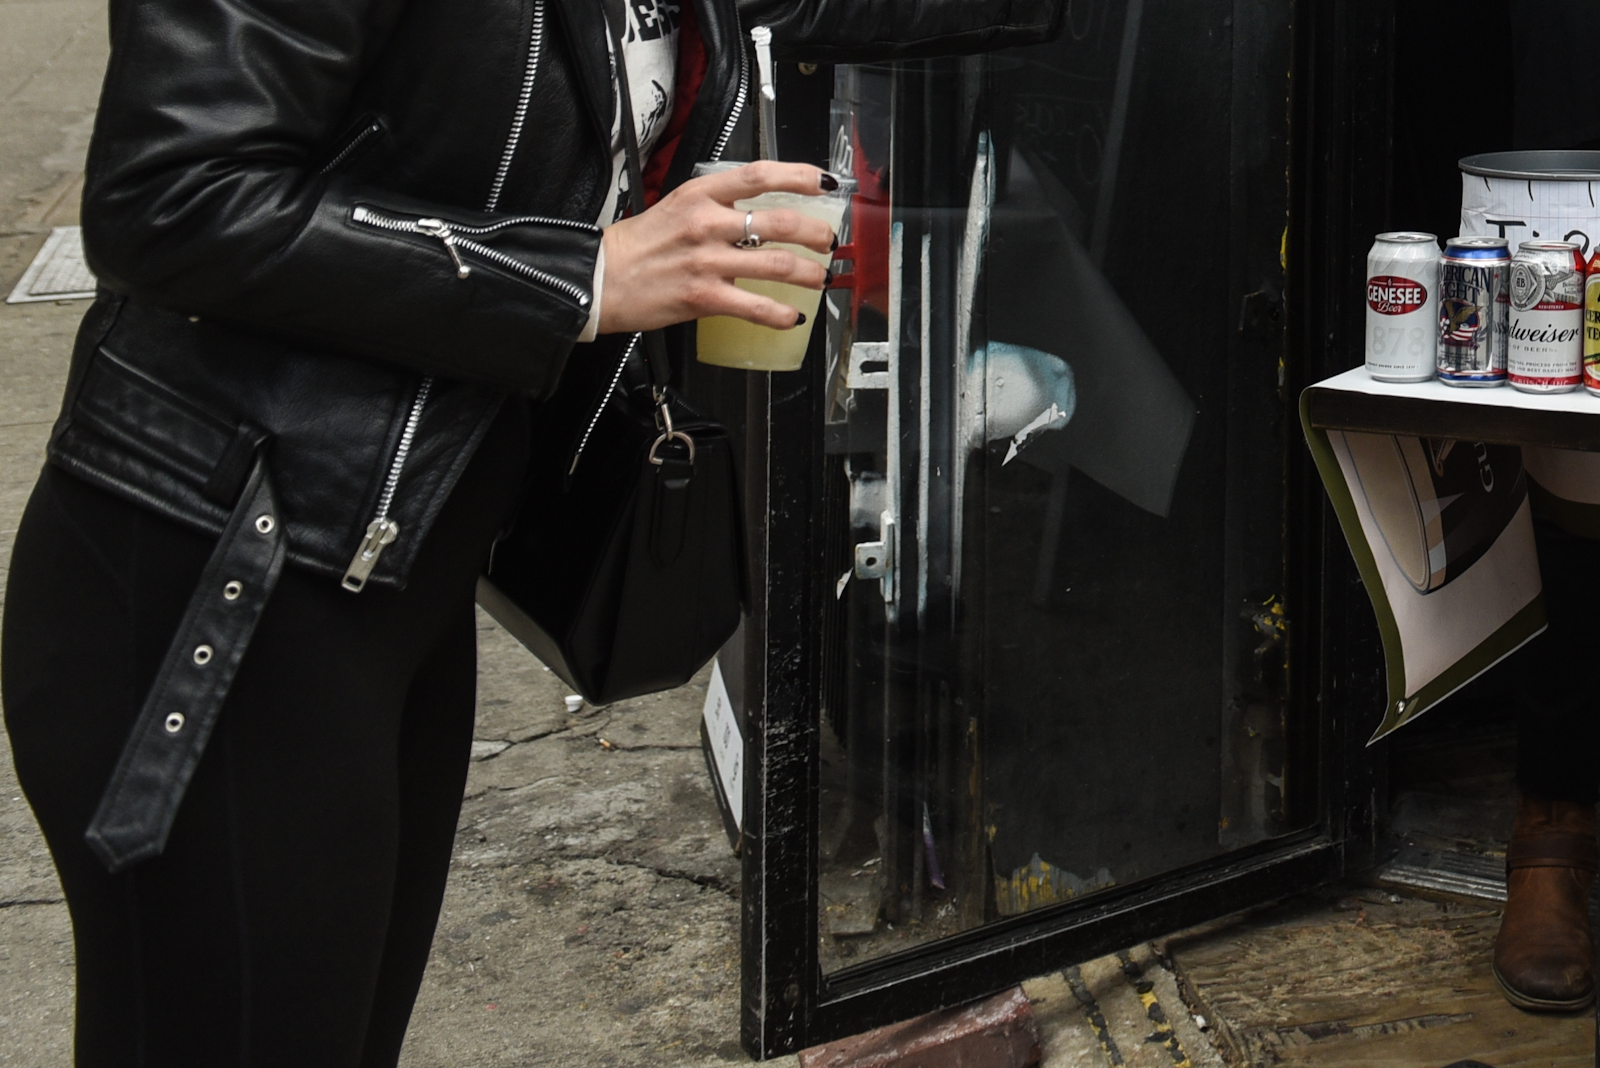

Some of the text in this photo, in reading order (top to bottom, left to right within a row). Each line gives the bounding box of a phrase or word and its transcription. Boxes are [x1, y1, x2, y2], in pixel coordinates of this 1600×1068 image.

[1366, 284, 1422, 305] GENESEE
[1377, 300, 1403, 313] Beer
[1509, 318, 1580, 344] dweiser
